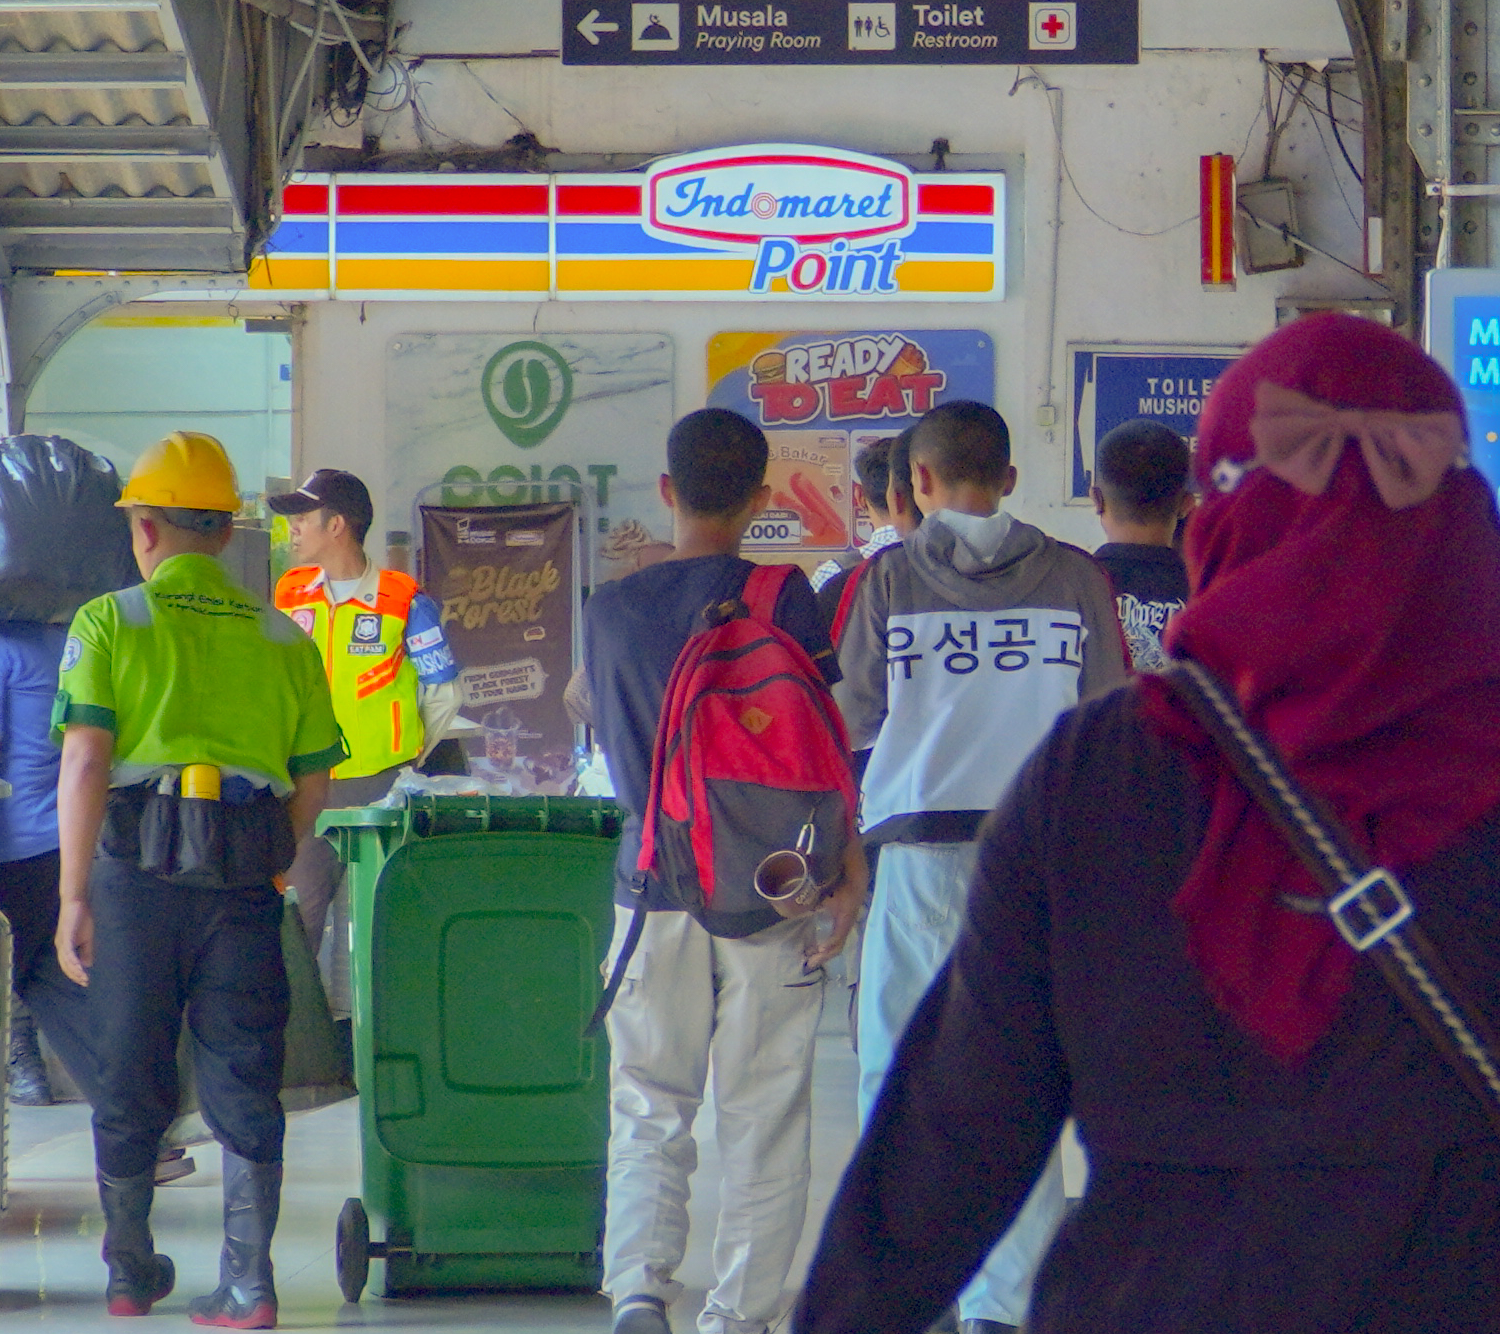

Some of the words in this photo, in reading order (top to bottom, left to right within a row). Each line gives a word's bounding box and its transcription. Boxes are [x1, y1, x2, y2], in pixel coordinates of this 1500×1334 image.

[697, 4, 789, 27] Musala
[912, 4, 984, 27] Toilet
[696, 31, 765, 53] Praying
[770, 31, 821, 48] Room
[912, 31, 998, 48] Restroom
[666, 176, 894, 219] Indomaret
[752, 239, 902, 292] Point
[785, 334, 905, 385] READY
[752, 383, 820, 422] TO
[826, 373, 944, 416] EAT
